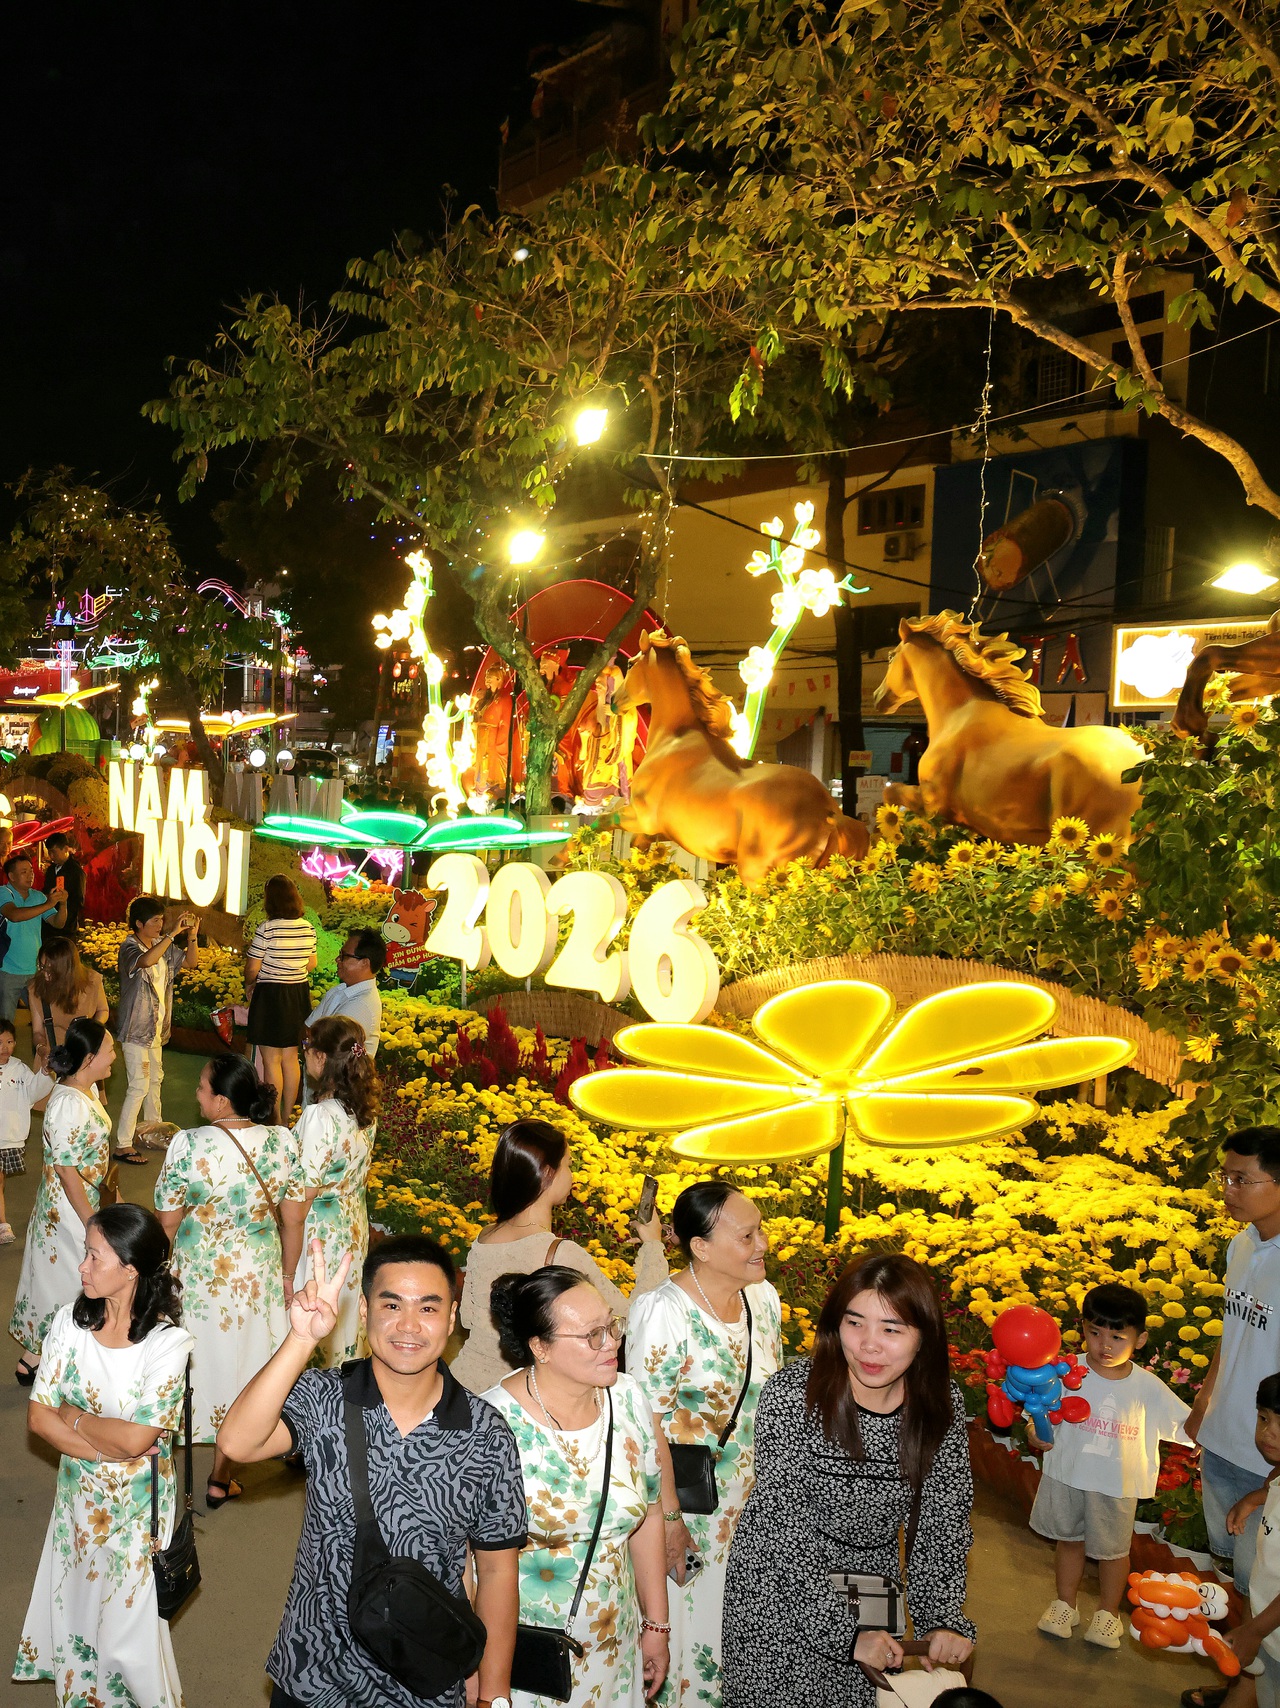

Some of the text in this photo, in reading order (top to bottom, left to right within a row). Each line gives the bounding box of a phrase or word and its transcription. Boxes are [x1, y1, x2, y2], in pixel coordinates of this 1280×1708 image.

[108, 752, 207, 834] NĂM
[142, 803, 251, 916] MỚI
[392, 951, 405, 959] XIN
[425, 853, 720, 1023] 2026
[1084, 1417, 1109, 1431] WAY
[1111, 1422, 1139, 1436] VIEWS
